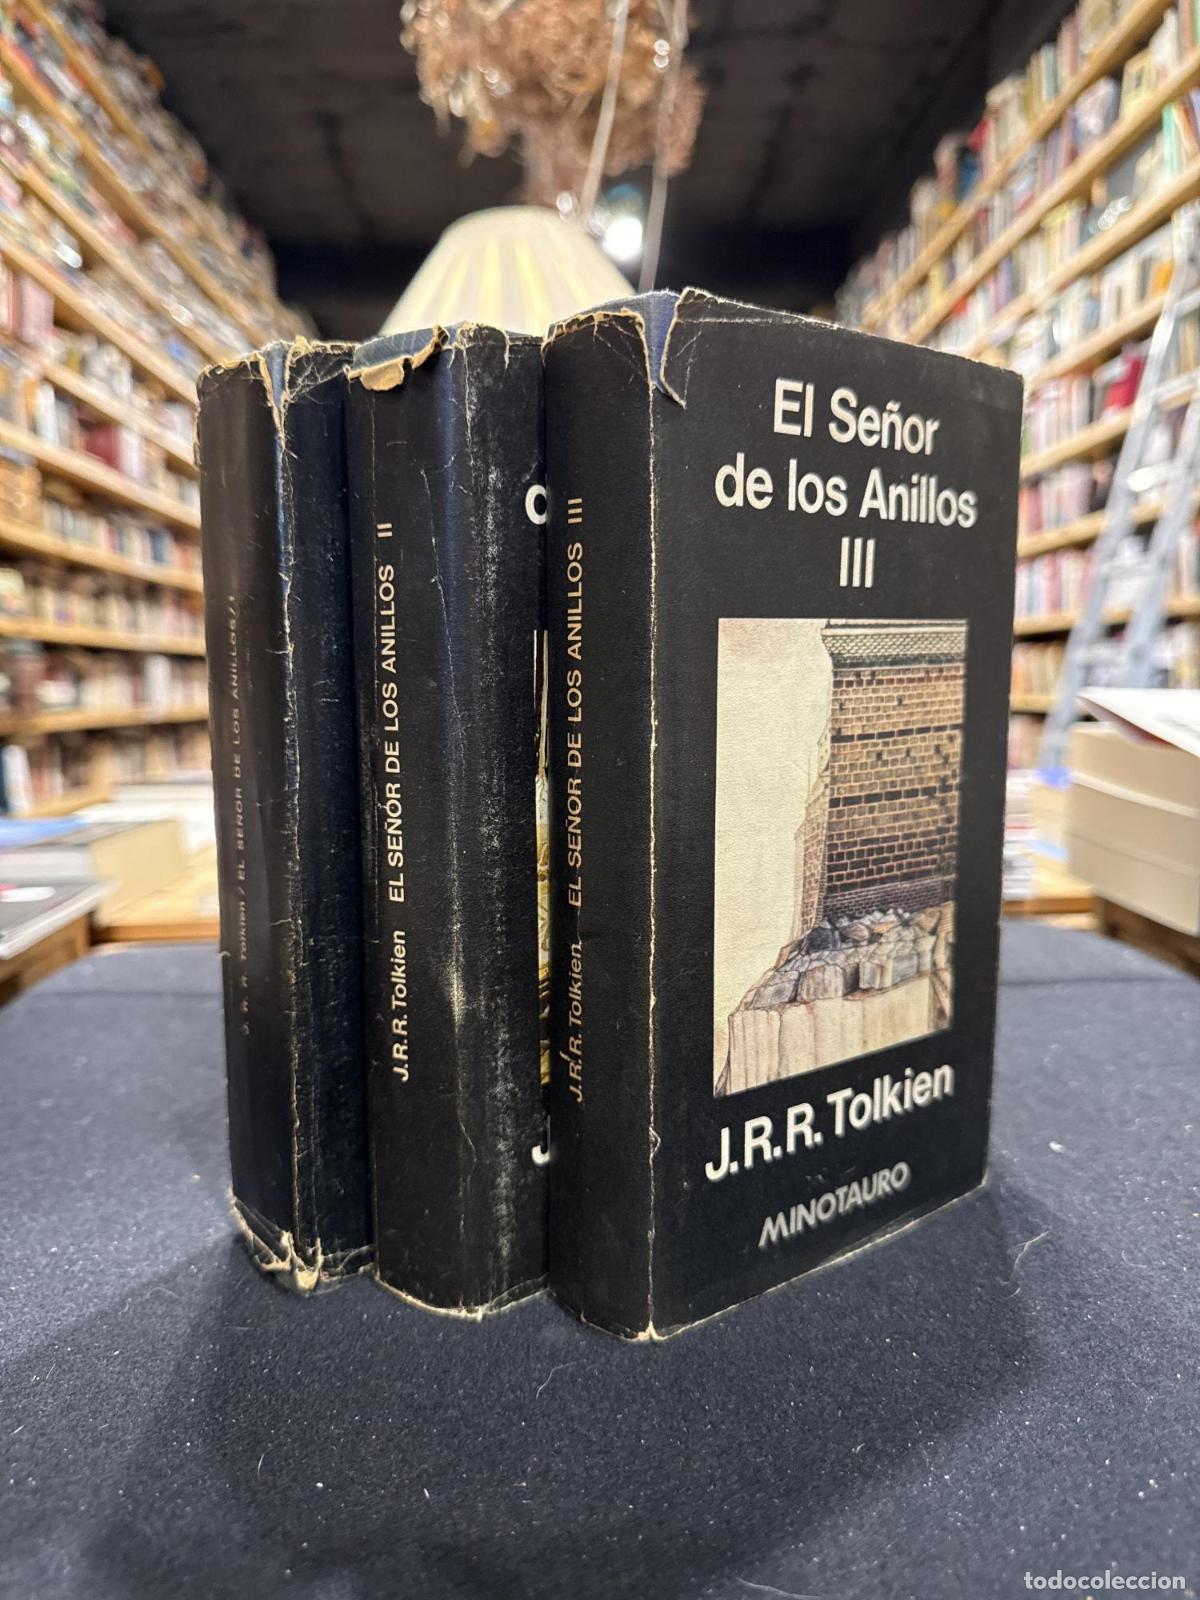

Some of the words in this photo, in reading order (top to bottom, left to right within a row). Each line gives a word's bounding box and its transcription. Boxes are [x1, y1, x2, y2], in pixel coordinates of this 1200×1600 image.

[773, 376, 815, 438] El
[828, 386, 940, 456] Señor
[567, 497, 583, 525] III
[714, 451, 774, 511] de
[787, 457, 849, 517] los
[858, 466, 979, 529] Anillos
[375, 522, 393, 539] II
[838, 536, 877, 589] III
[378, 564, 397, 674] ANILLOS
[566, 541, 583, 660] ANILLOS
[382, 682, 399, 732] LOS
[566, 668, 583, 723] LOS
[231, 707, 241, 746] LOS
[567, 731, 582, 768] DE
[232, 753, 242, 778] DE
[384, 741, 401, 774] DE
[384, 782, 404, 868] SEÑOR
[564, 777, 582, 868] SEÑOR
[388, 873, 405, 902] EL
[567, 875, 582, 907] EL
[389, 930, 407, 1009] Tolkien
[567, 942, 583, 1027] Tolkien
[825, 1063, 955, 1138] Tolkien
[757, 1160, 911, 1249] MINOTAURO
